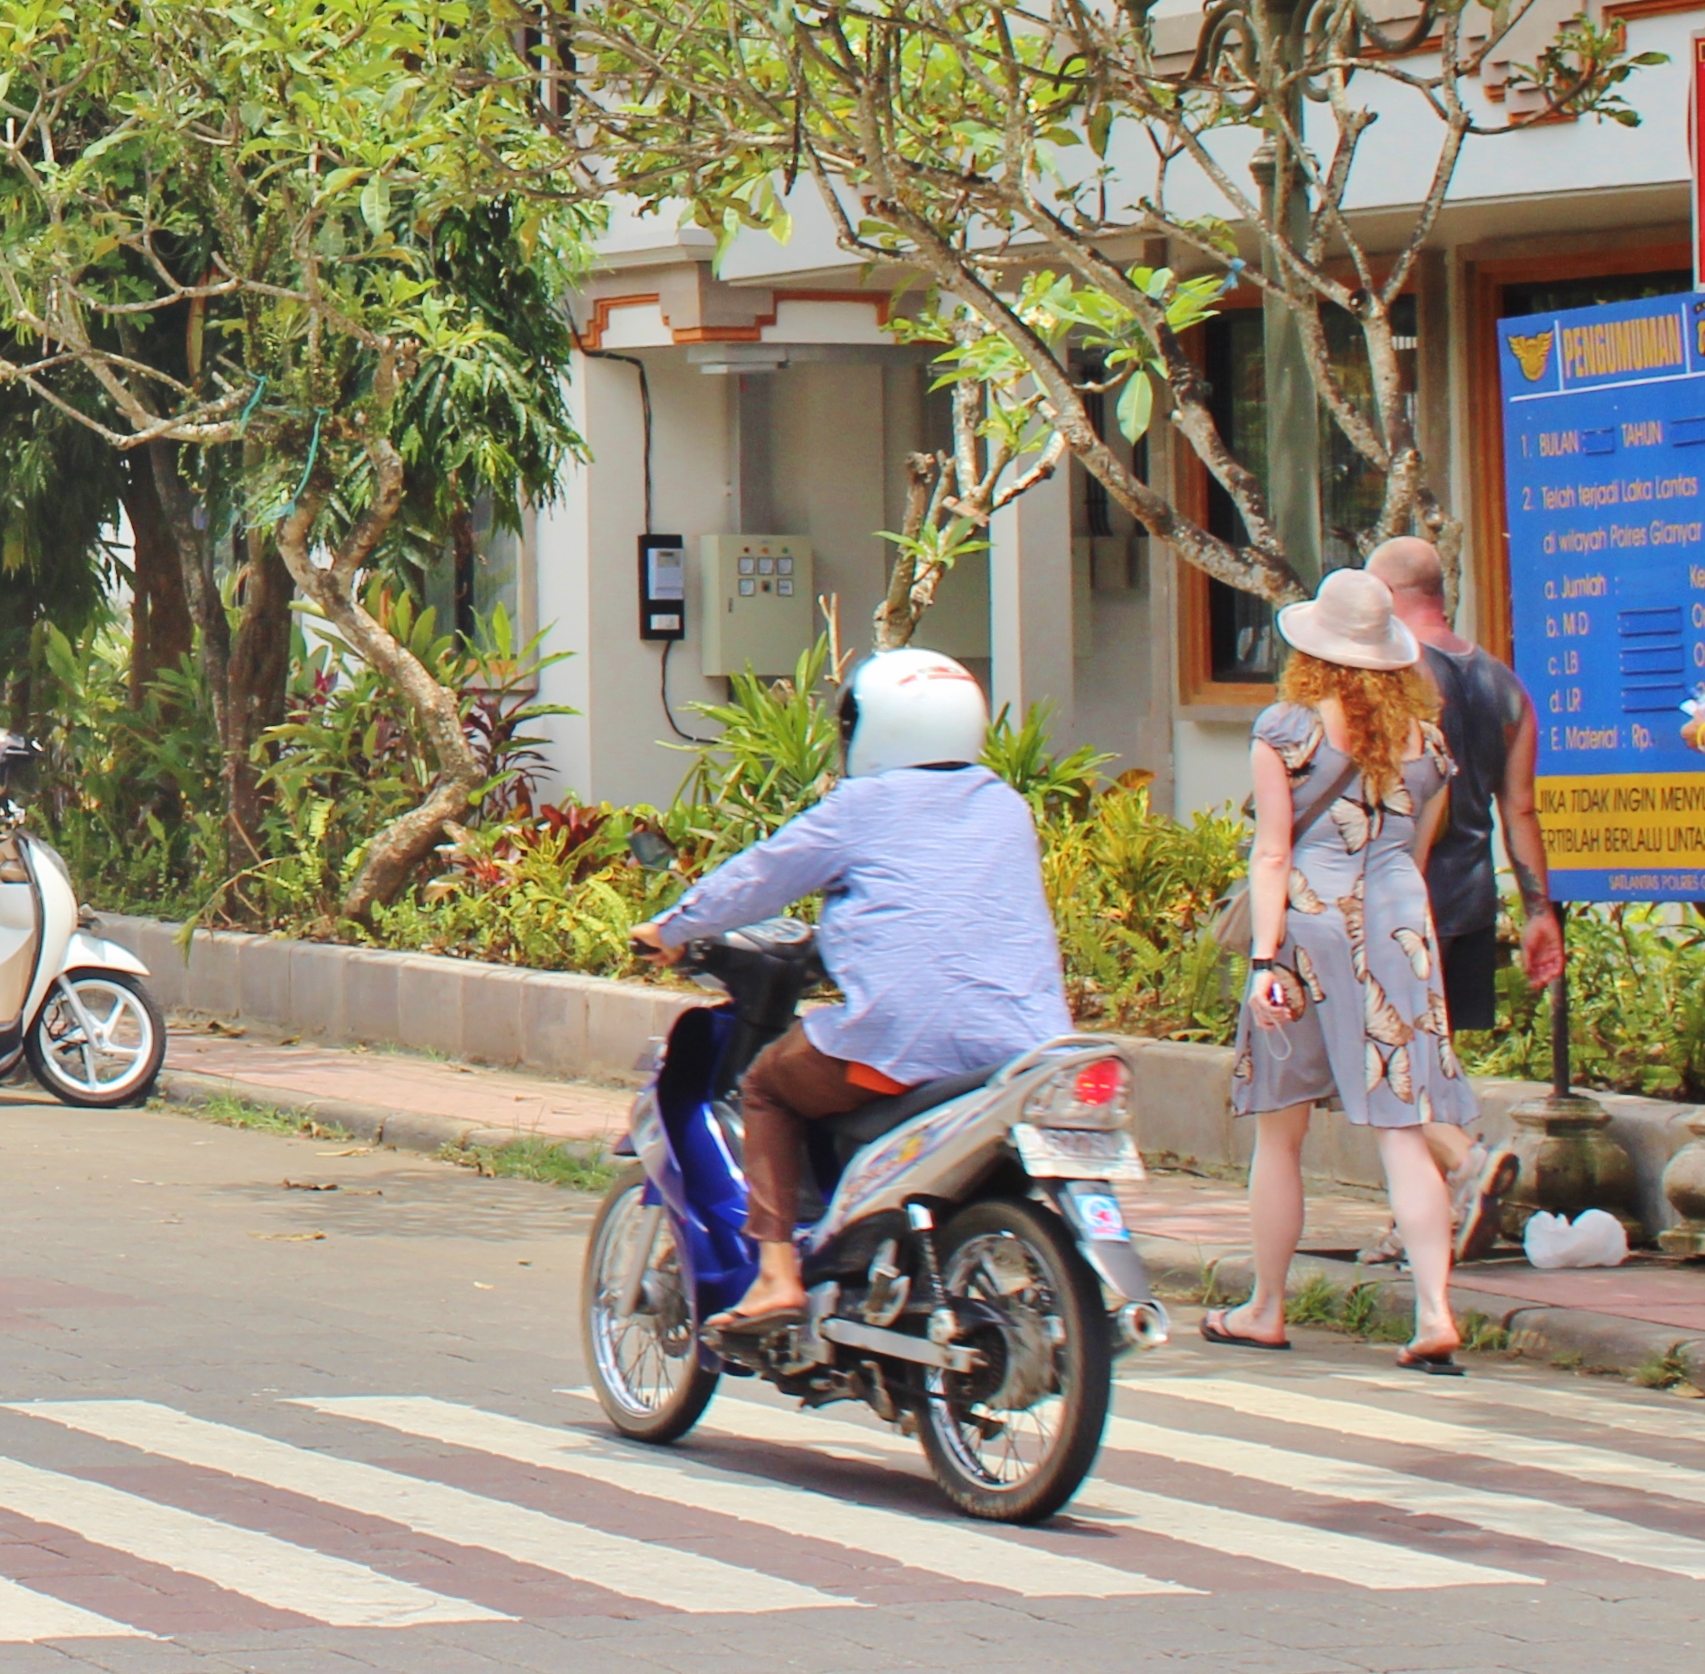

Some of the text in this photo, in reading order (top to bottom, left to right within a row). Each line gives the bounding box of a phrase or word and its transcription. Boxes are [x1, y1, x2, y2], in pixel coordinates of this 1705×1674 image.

[1562, 313, 1683, 379] PENGUMUMAN
[1538, 429, 1580, 457] BULAN
[1621, 420, 1663, 448] TAHUN
[1541, 483, 1576, 510] Telah
[1577, 478, 1620, 510] terjadi
[1620, 477, 1653, 503] Laka
[1655, 473, 1698, 499] Lantas
[1543, 519, 1703, 556] di wilayah Polres Gianyar
[1560, 572, 1607, 599] Jumlah
[1565, 724, 1619, 750] Material
[1571, 787, 1610, 813] TIDAK
[1613, 786, 1657, 813] INGIN
[1604, 827, 1663, 853] BERLALU
[1667, 825, 1705, 852] LINTA
